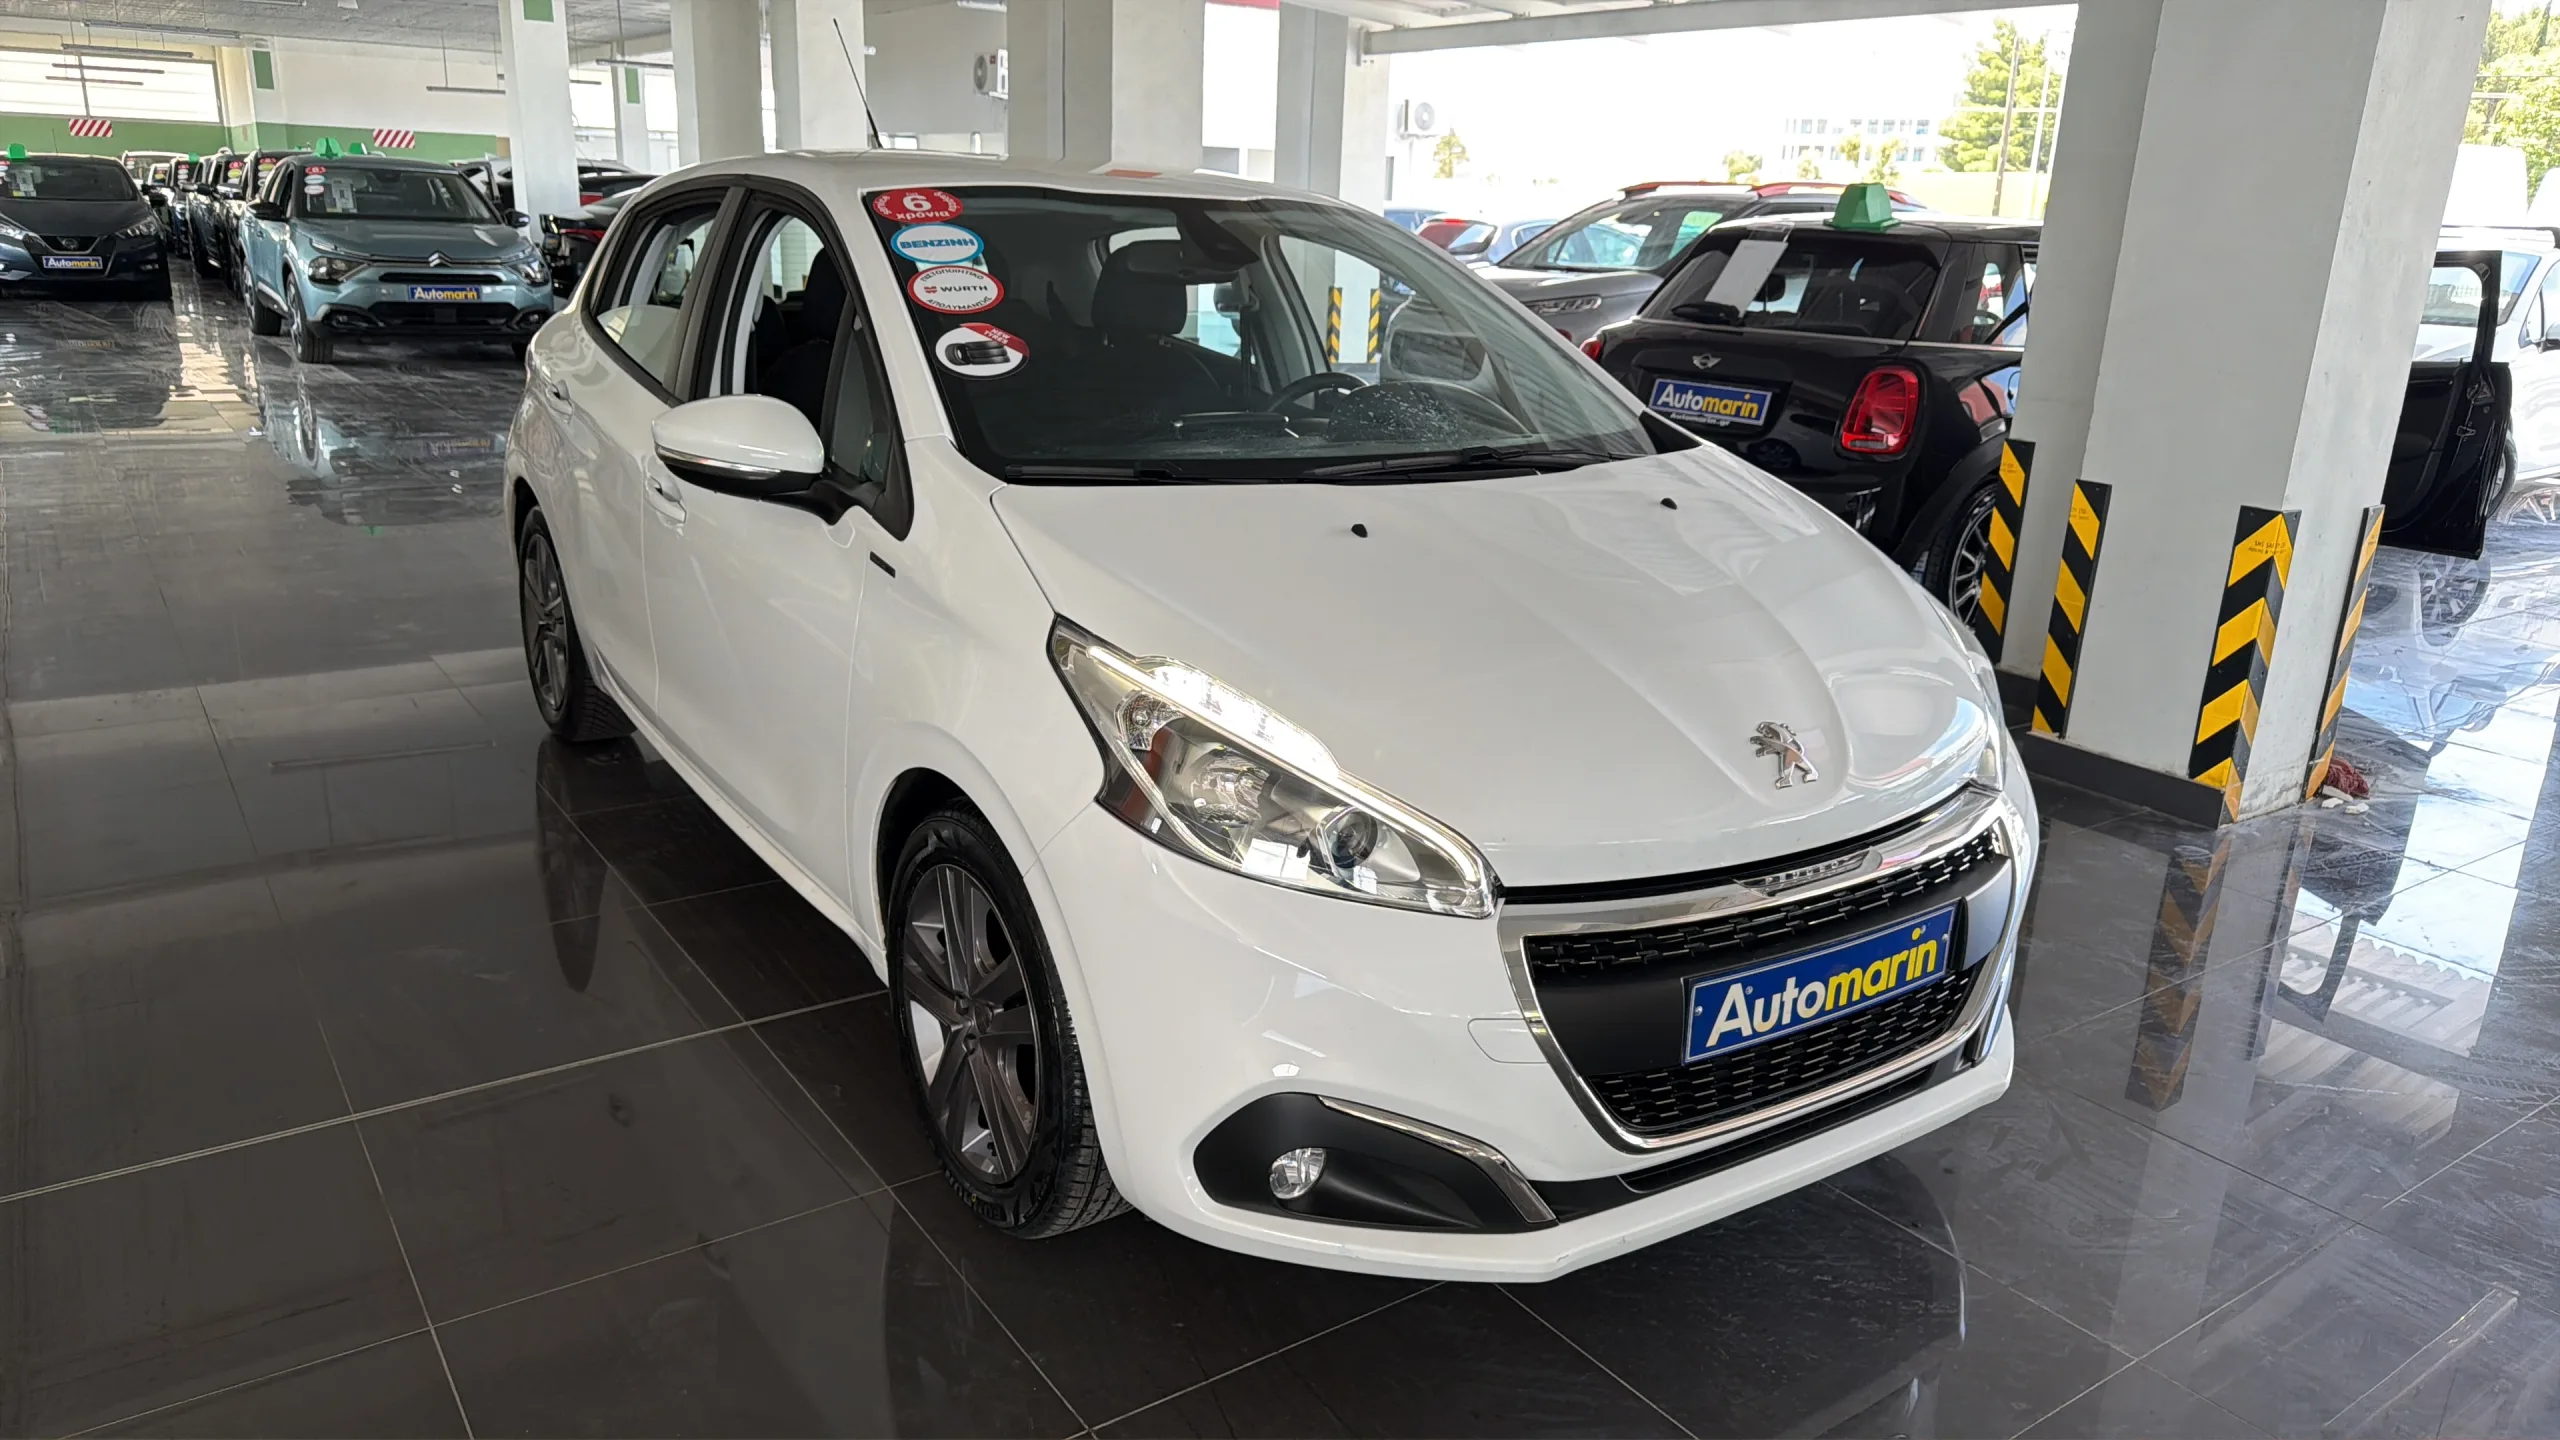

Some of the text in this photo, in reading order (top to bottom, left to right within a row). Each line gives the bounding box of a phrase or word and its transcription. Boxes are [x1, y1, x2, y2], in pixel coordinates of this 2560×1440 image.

[903, 195, 931, 212] 6
[896, 211, 950, 220] χρόνια
[900, 238, 976, 249] ΒΕΝΖΙΝΗ
[48, 257, 99, 268] Automarin
[414, 286, 478, 300] Automarin
[991, 328, 1011, 339] NEW
[1656, 383, 1759, 419] Automarin
[1705, 927, 1938, 1048] Automarin
